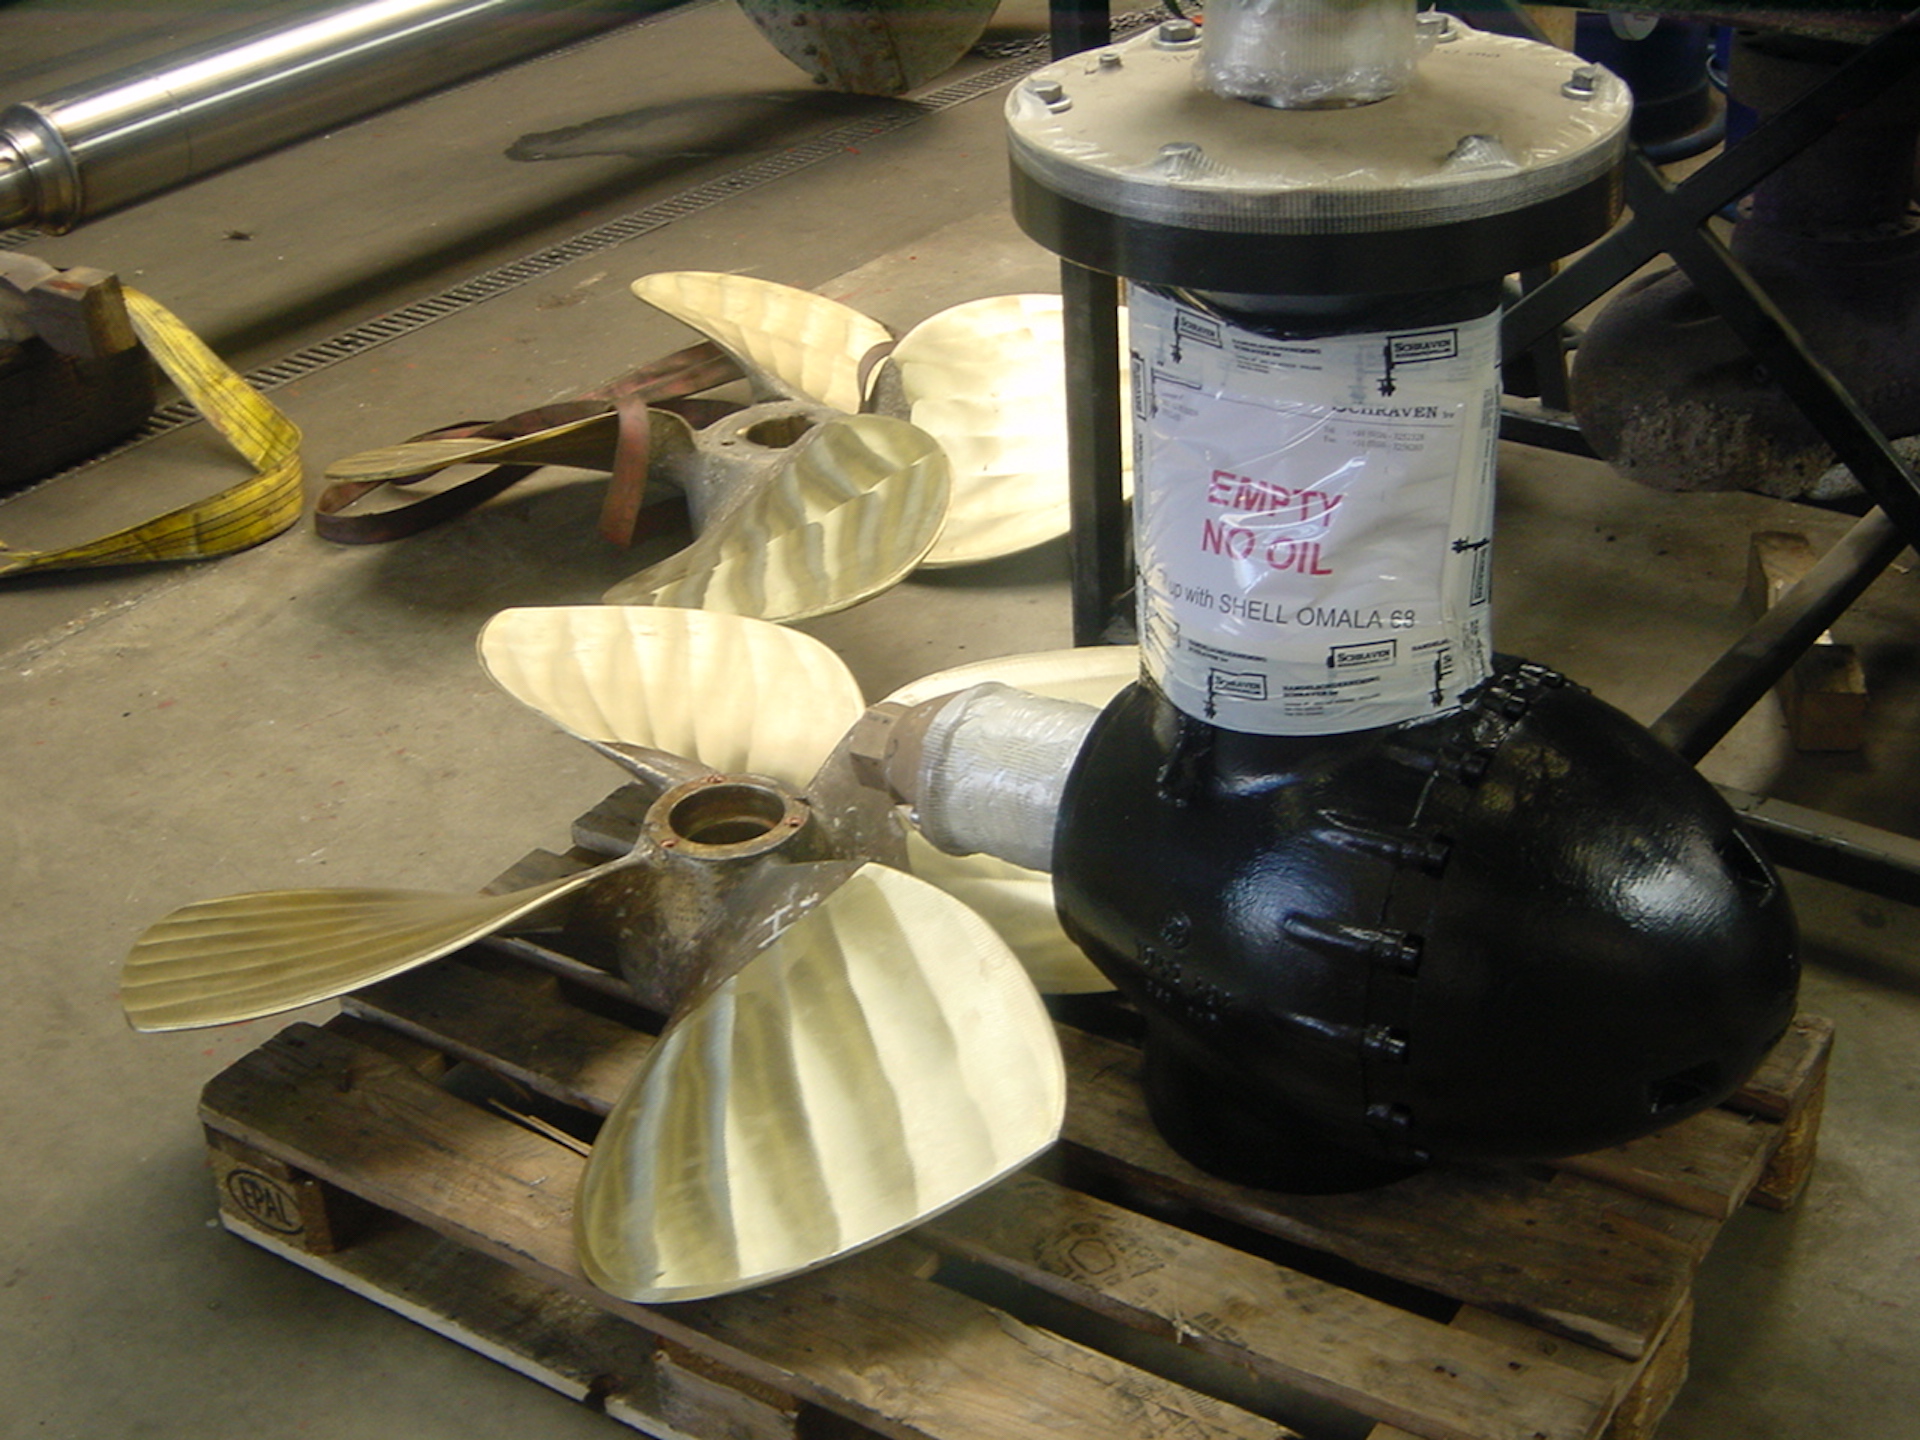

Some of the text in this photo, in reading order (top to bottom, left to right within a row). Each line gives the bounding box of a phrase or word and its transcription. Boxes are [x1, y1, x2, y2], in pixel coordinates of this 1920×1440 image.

[1207, 469, 1345, 528] EMPTY
[1202, 518, 1333, 575] NO OIL
[1185, 585, 1214, 609] with
[1218, 593, 1288, 624] SHELL
[1296, 606, 1383, 629] OMALA
[1390, 609, 1416, 630] 68
